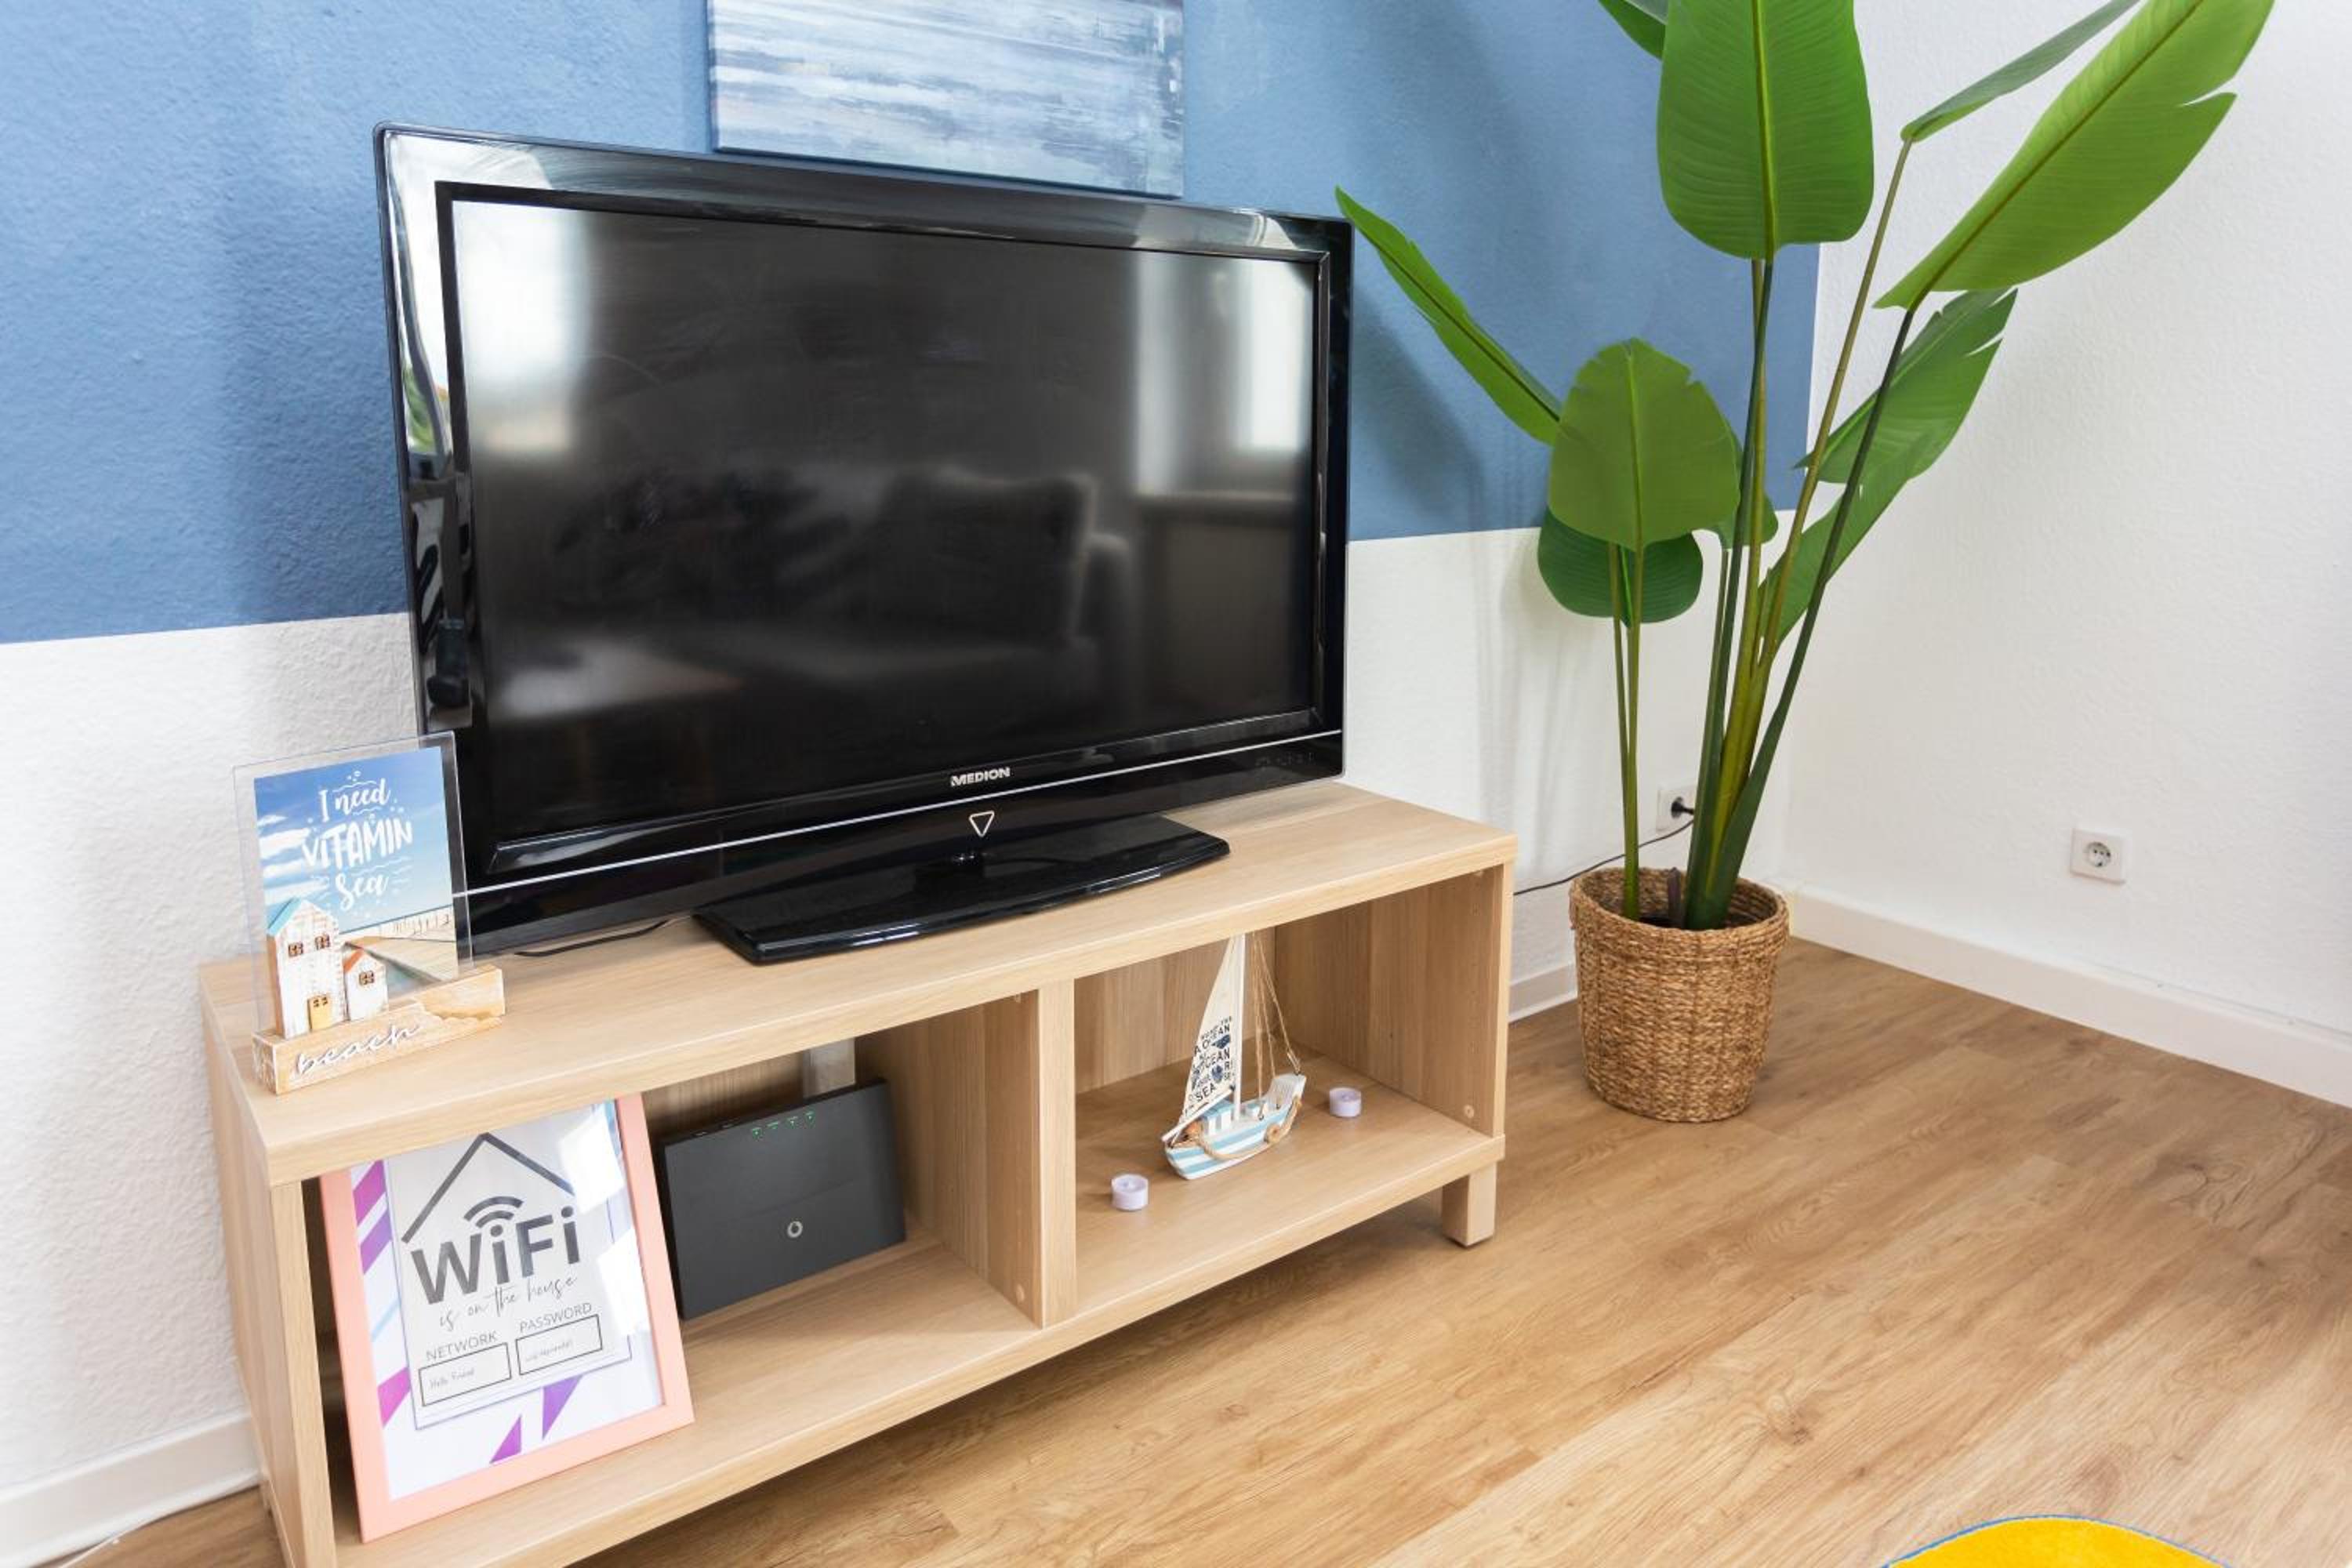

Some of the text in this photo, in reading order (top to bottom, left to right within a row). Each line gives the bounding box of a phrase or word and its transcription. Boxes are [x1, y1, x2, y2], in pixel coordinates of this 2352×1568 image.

[950, 767, 1011, 787] MEDION
[318, 778, 390, 822] I need
[302, 818, 412, 869] VITAMIN
[335, 873, 389, 911] Sea
[291, 1023, 426, 1079] beach
[411, 1206, 580, 1305] WiFi
[440, 1276, 578, 1330] is on the house
[520, 1302, 592, 1332] PASSWORD
[426, 1330, 498, 1361] NETWORK
